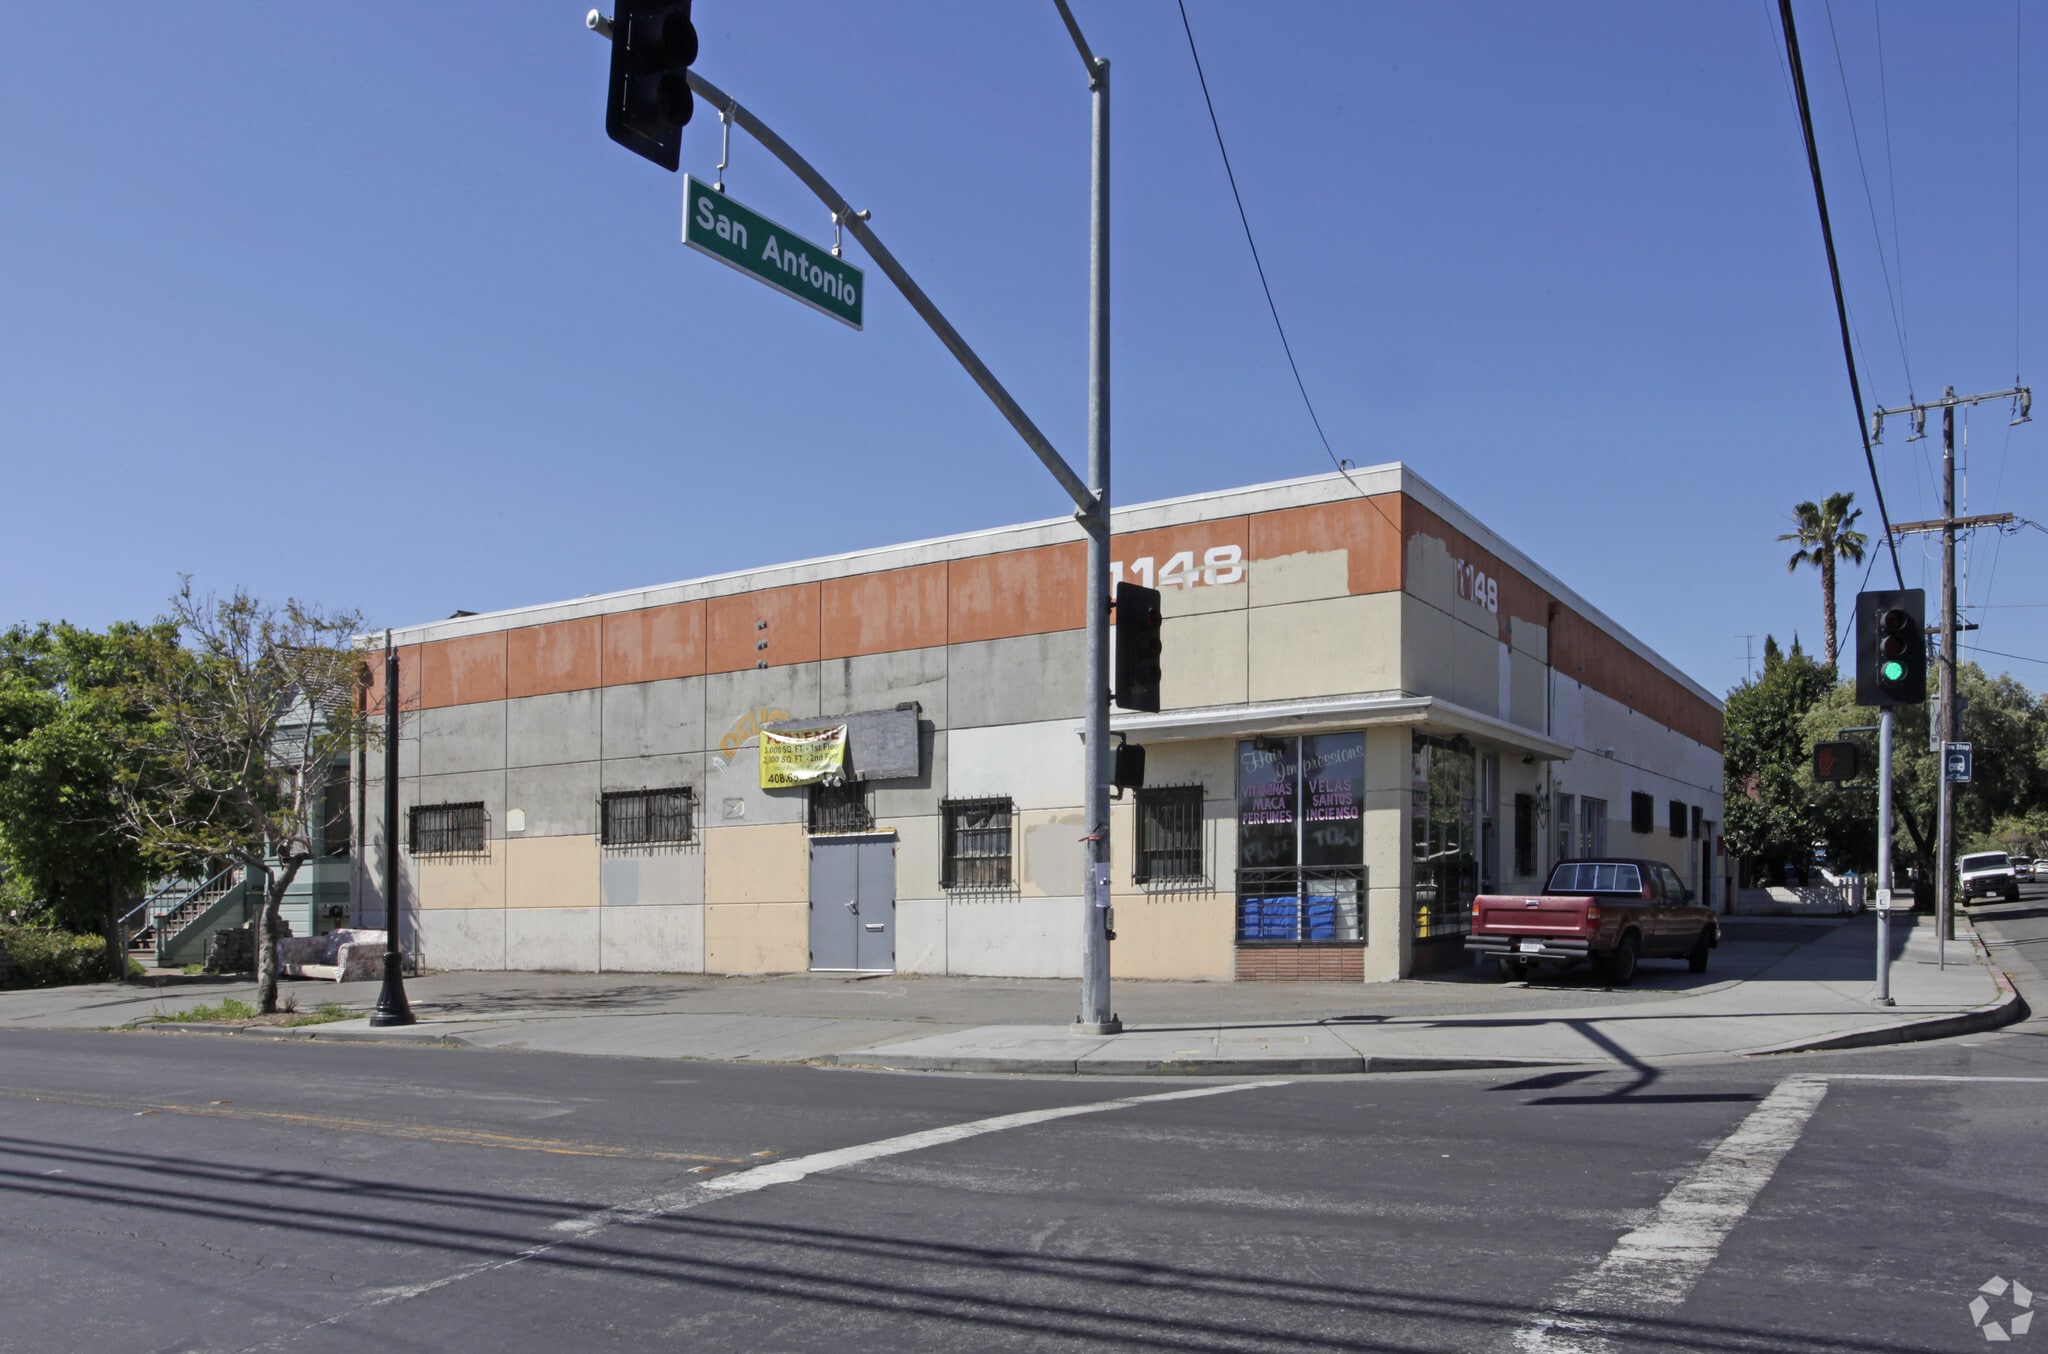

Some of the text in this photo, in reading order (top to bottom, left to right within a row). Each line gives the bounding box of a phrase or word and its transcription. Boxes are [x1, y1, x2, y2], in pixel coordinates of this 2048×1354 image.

[696, 196, 856, 306] San Antonio
[1110, 544, 1242, 599] 1148
[1457, 558, 1498, 614] 1148
[824, 749, 839, 760] Foor
[1241, 749, 1284, 773] Hair
[1273, 745, 1364, 784] Impressions
[1242, 783, 1292, 798] VITAMINAS
[1309, 779, 1351, 793] VELAS
[1253, 798, 1286, 811] MACA
[1312, 793, 1353, 807] SANTOS
[1306, 806, 1358, 821] INCIENSO
